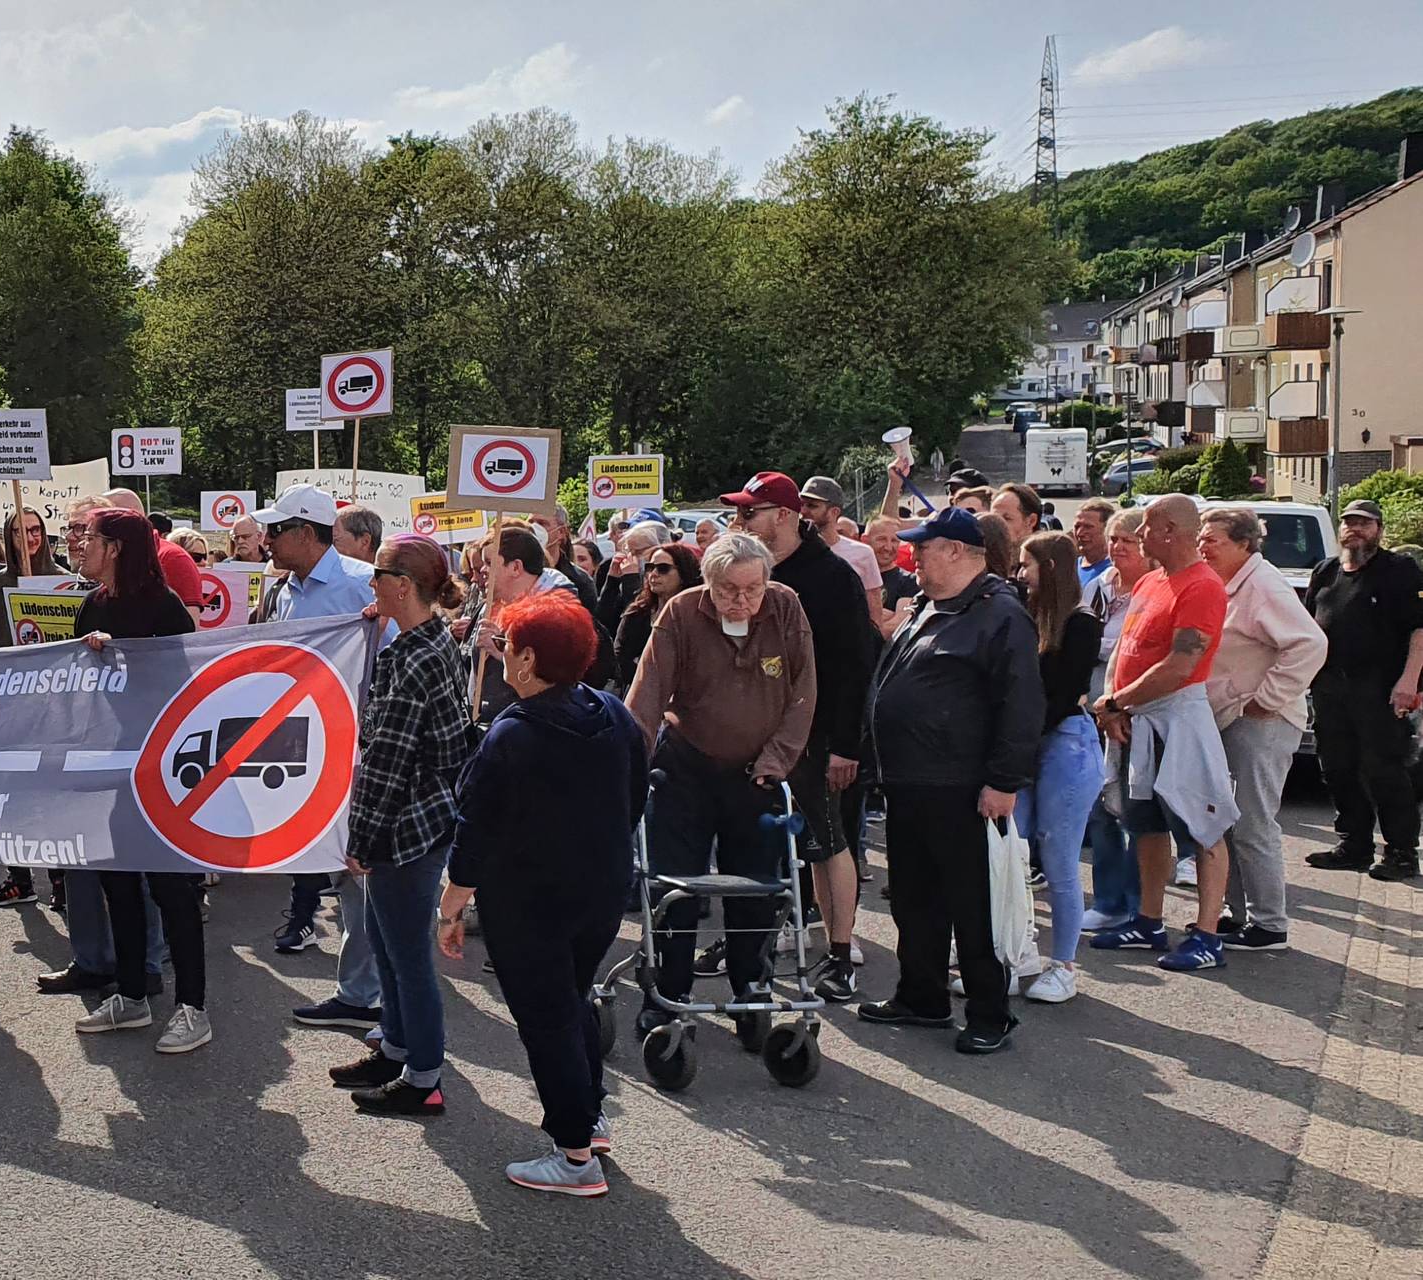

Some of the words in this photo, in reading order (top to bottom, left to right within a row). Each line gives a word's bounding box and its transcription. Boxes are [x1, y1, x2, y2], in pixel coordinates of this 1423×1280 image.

[20, 420, 31, 428] aus
[10, 430, 44, 439] verbannen!
[140, 438, 160, 446] ROT
[162, 437, 175, 446] für
[15, 445, 23, 453] an
[23, 444, 34, 453] der
[140, 448, 174, 456] Transit
[140, 457, 165, 466] -LKW
[601, 463, 653, 473] Lüdenscheid
[633, 481, 650, 490] Zone
[456, 516, 474, 524] Zone
[19, 602, 79, 618] Lüdenschei
